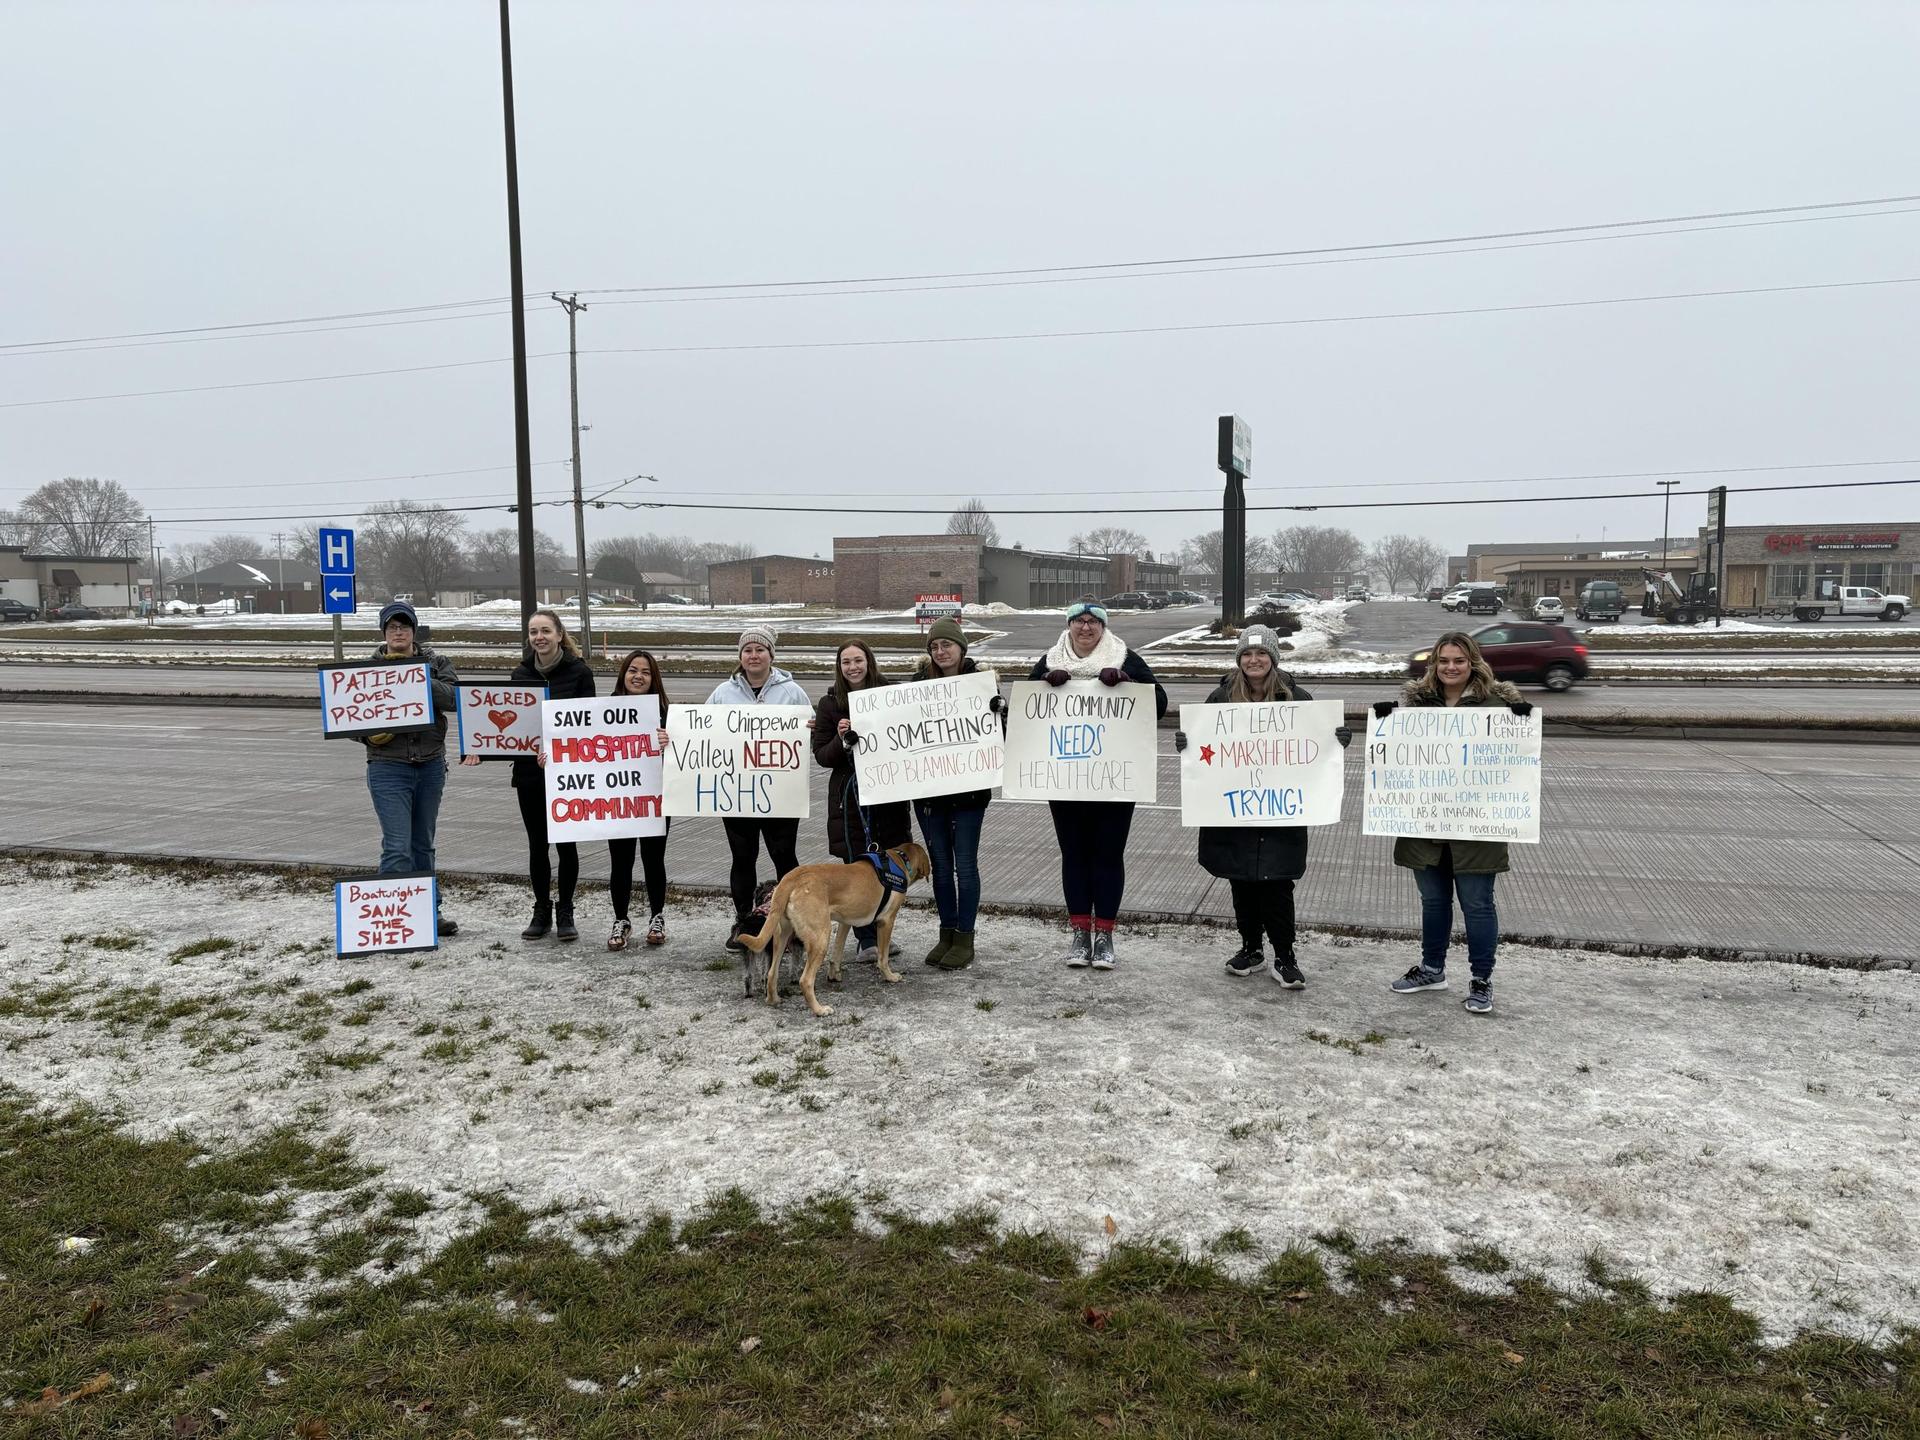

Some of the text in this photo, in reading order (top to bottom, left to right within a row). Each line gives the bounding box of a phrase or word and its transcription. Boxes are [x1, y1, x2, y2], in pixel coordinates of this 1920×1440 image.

[326, 534, 348, 568] H
[920, 594, 957, 602] AVAILABLE
[331, 667, 426, 696] PATIENTS
[353, 688, 396, 704] OVER
[469, 689, 536, 708] SACRED
[856, 680, 960, 714] OUR GOVERNMENT
[920, 696, 982, 718] NEEDS TO
[1025, 692, 1136, 721] OUR COMMUNITY
[330, 702, 424, 725] PROFITS
[554, 708, 638, 727] SAVE OUR
[685, 709, 799, 739] The Chippewa
[1215, 705, 1299, 736] AT LEAST
[858, 712, 998, 756] DO SOMETHING!
[1392, 712, 1480, 738] HOSPITALS
[1486, 714, 1491, 736] 1
[1492, 714, 1532, 726] CANCER
[1494, 727, 1534, 739] CENTER
[472, 733, 540, 753] STRONG
[552, 734, 660, 763] HOSPITAL
[1049, 724, 1106, 756] NEEDS
[672, 739, 802, 776] Valley NEEDS
[1220, 738, 1319, 768] MARSHFIELD
[1370, 742, 1520, 766] 19 CLINICS 1 INPATIENT
[1473, 755, 1500, 766] REHAB
[864, 746, 1004, 788] STOP BLAMING COVID
[1018, 760, 1136, 792] HEALTHCARE
[1250, 768, 1264, 788] IS
[557, 770, 642, 791] SAVE OUR
[1371, 768, 1512, 790] 1 DRUG & REHAB CENTER
[1384, 780, 1416, 790] ALCOHOL
[696, 773, 772, 814] HSHS
[1223, 788, 1303, 818] TRYING!
[1368, 792, 1374, 805] A
[1378, 792, 1416, 806] WOUND
[1456, 791, 1482, 803] HOME
[1487, 792, 1520, 803] HEALTH
[551, 794, 662, 822] COMMUNITY
[1412, 806, 1428, 819] LAB
[1430, 804, 1438, 818] &
[1368, 820, 1378, 832] IV
[350, 885, 428, 903] Boatwright
[358, 904, 412, 920] SANK
[370, 918, 406, 930] THE
[357, 928, 414, 947] SHIP
